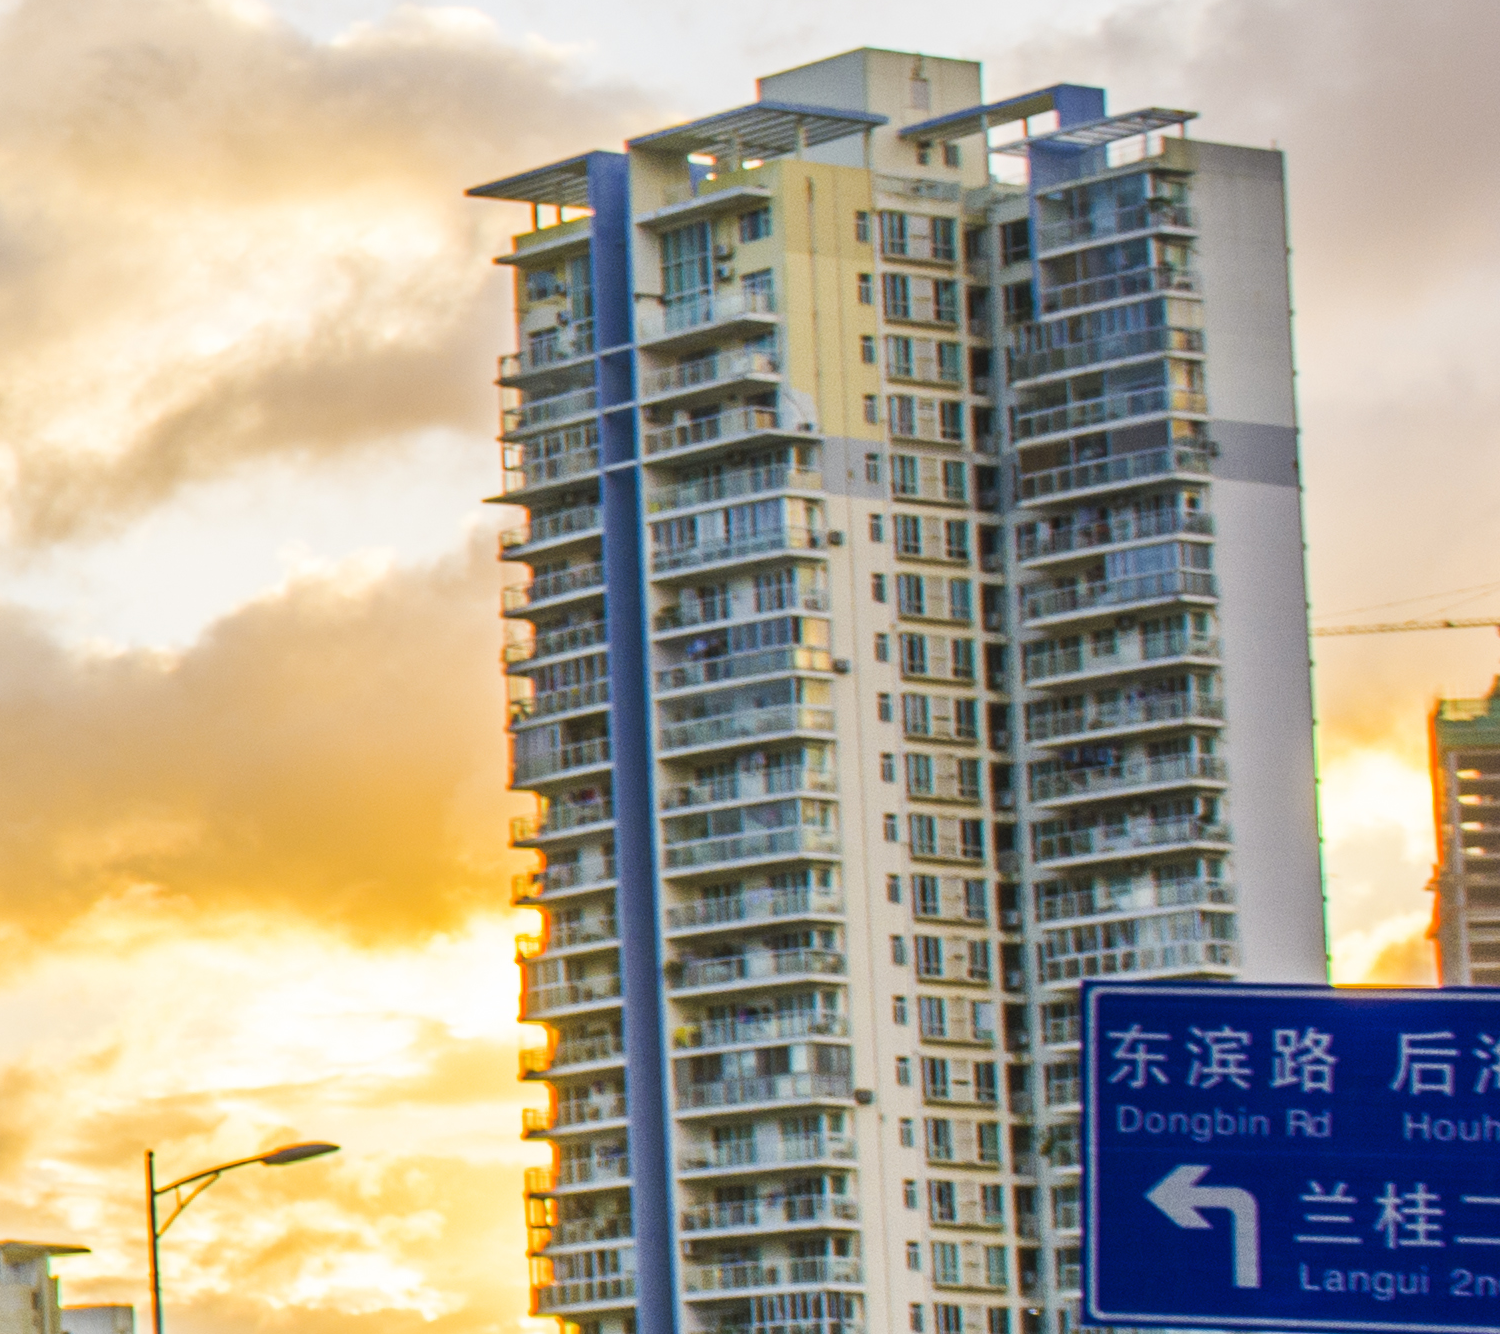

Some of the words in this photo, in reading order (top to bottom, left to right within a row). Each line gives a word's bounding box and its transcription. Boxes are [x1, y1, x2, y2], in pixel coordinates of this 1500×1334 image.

[1107, 1024, 1338, 1093] 东滨路
[1116, 1104, 1270, 1142] Dongbin
[1286, 1109, 1333, 1138] Rd
[1300, 1263, 1430, 1301] Langui
